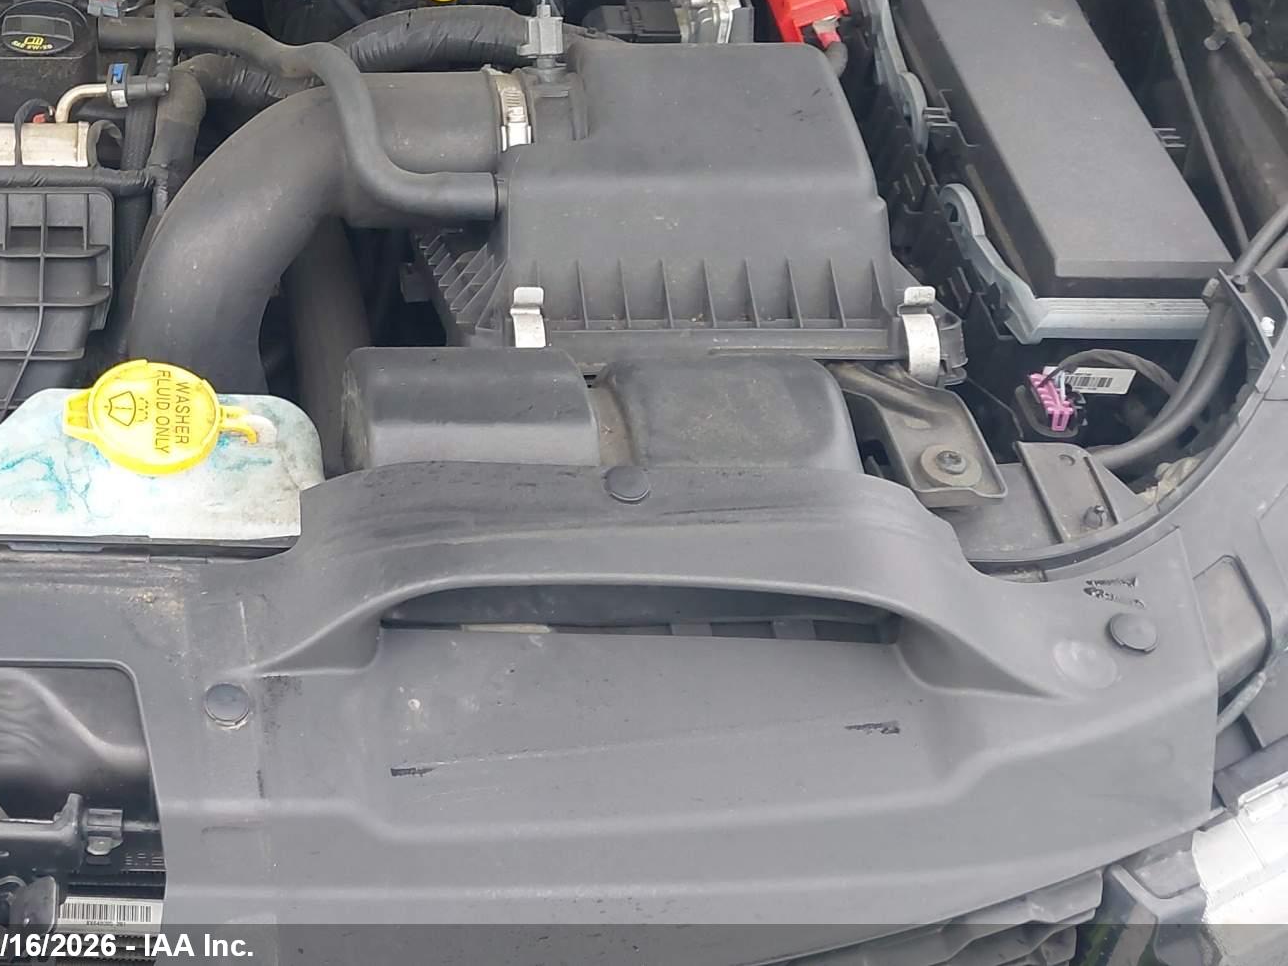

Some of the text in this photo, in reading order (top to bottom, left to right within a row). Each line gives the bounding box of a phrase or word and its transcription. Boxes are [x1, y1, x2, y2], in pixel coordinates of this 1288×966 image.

[154, 369, 171, 454] FLUID ONLY
[175, 381, 191, 446] WASHER
